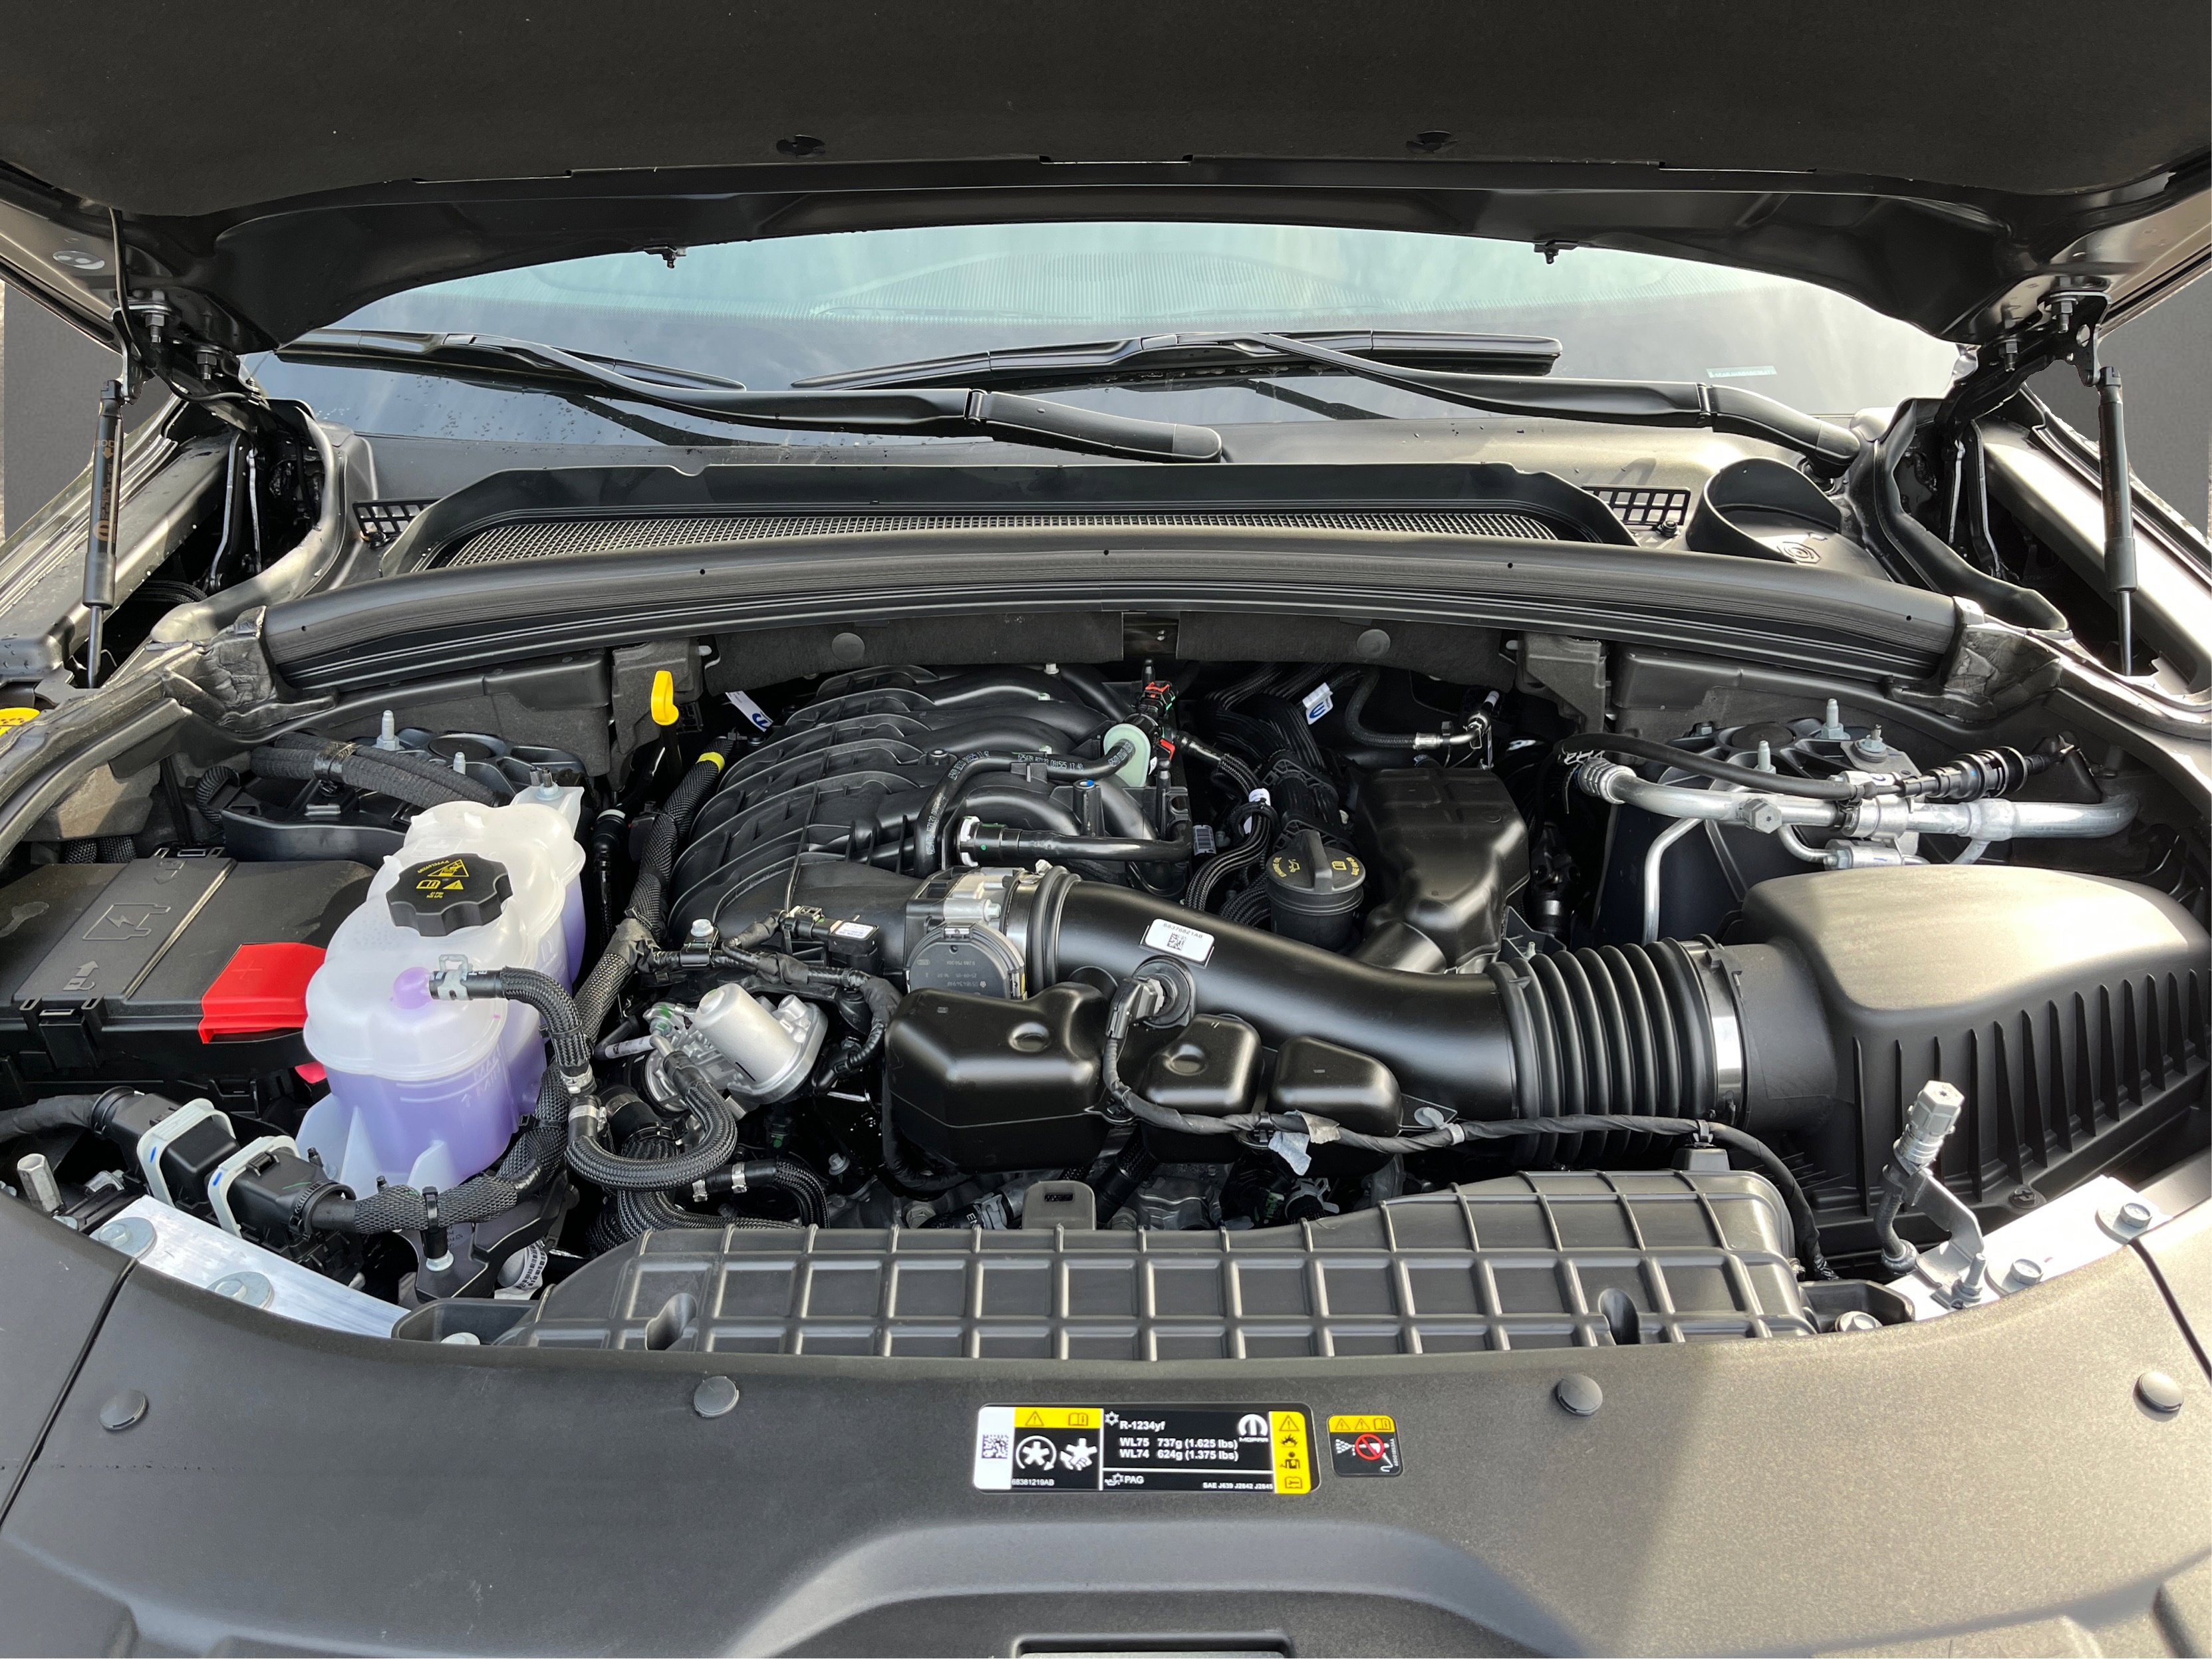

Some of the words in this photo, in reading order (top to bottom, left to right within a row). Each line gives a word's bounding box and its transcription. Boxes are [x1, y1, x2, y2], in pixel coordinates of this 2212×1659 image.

[1119, 1420, 1165, 1432] R-1234yf
[1119, 1437, 1149, 1447] WL75
[1157, 1438, 1182, 1450] 737g
[1184, 1438, 1216, 1450] (1.625
[1218, 1439, 1238, 1450] lbs)
[1119, 1449, 1149, 1459] WL74
[1157, 1449, 1182, 1461] 624g
[1184, 1450, 1216, 1461] (1.375
[1218, 1450, 1238, 1462] lbs)
[1124, 1475, 1145, 1484] PAG
